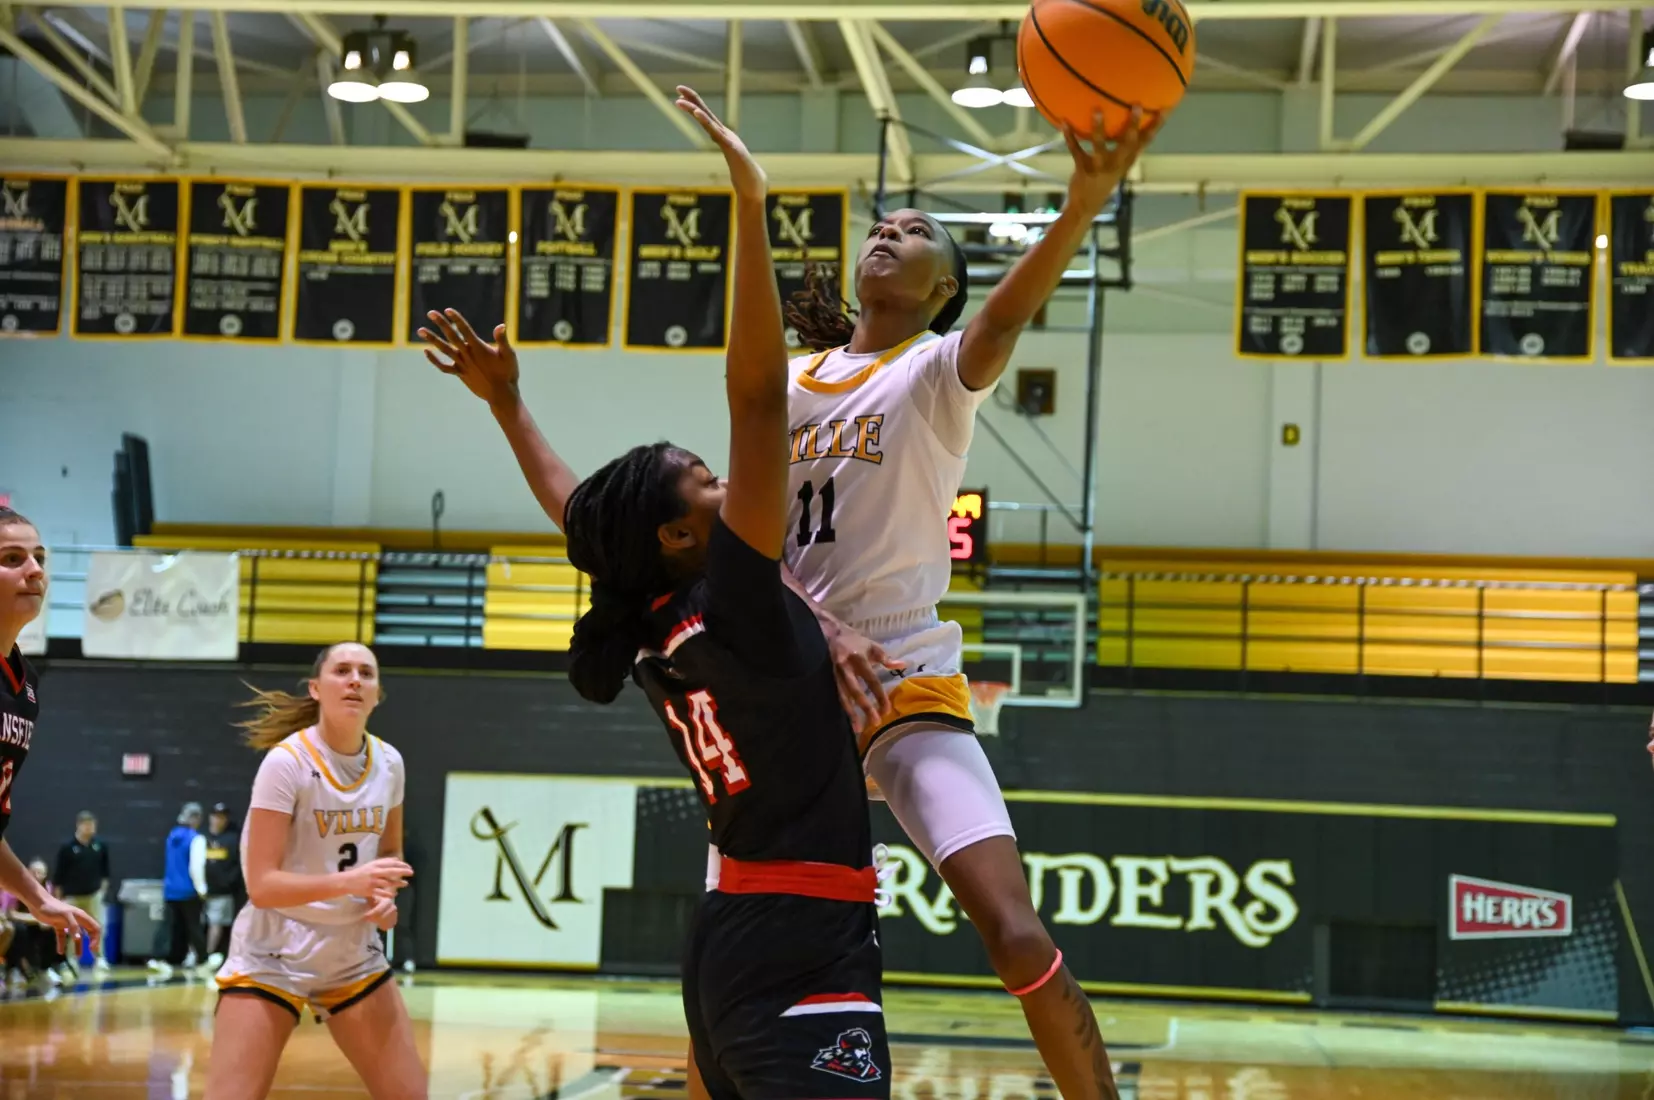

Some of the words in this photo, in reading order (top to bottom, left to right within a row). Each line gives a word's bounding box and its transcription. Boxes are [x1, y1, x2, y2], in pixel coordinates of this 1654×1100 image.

[789, 414, 884, 465] ILLE
[797, 476, 836, 547] 11
[664, 688, 751, 805] 14
[313, 805, 384, 838] VILLE
[338, 842, 358, 873] 2
[1462, 890, 1558, 929] HERR'S
